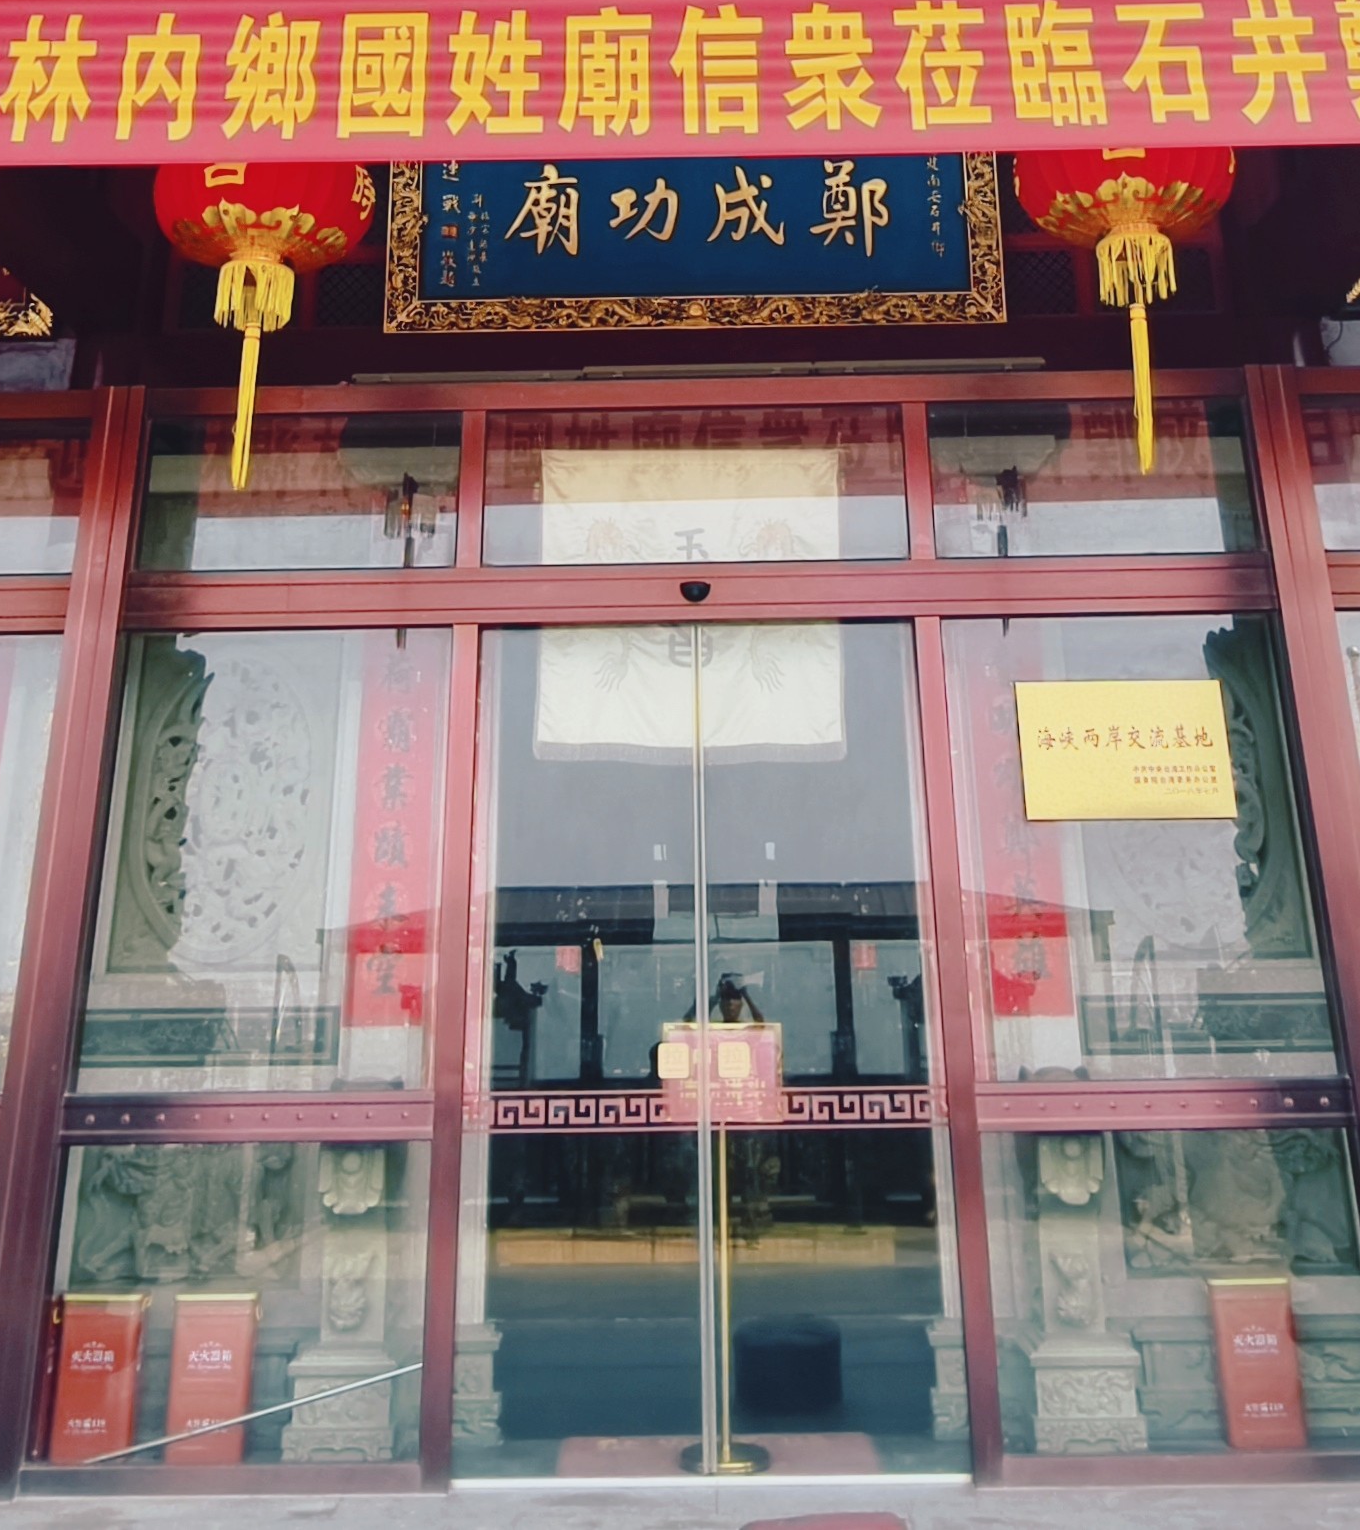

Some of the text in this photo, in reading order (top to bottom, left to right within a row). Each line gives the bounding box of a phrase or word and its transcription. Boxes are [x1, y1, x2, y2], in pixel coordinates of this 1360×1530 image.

[504, 158, 890, 258] 鄭成功廟
[1038, 724, 1214, 751] 海峡两岸交流基地
